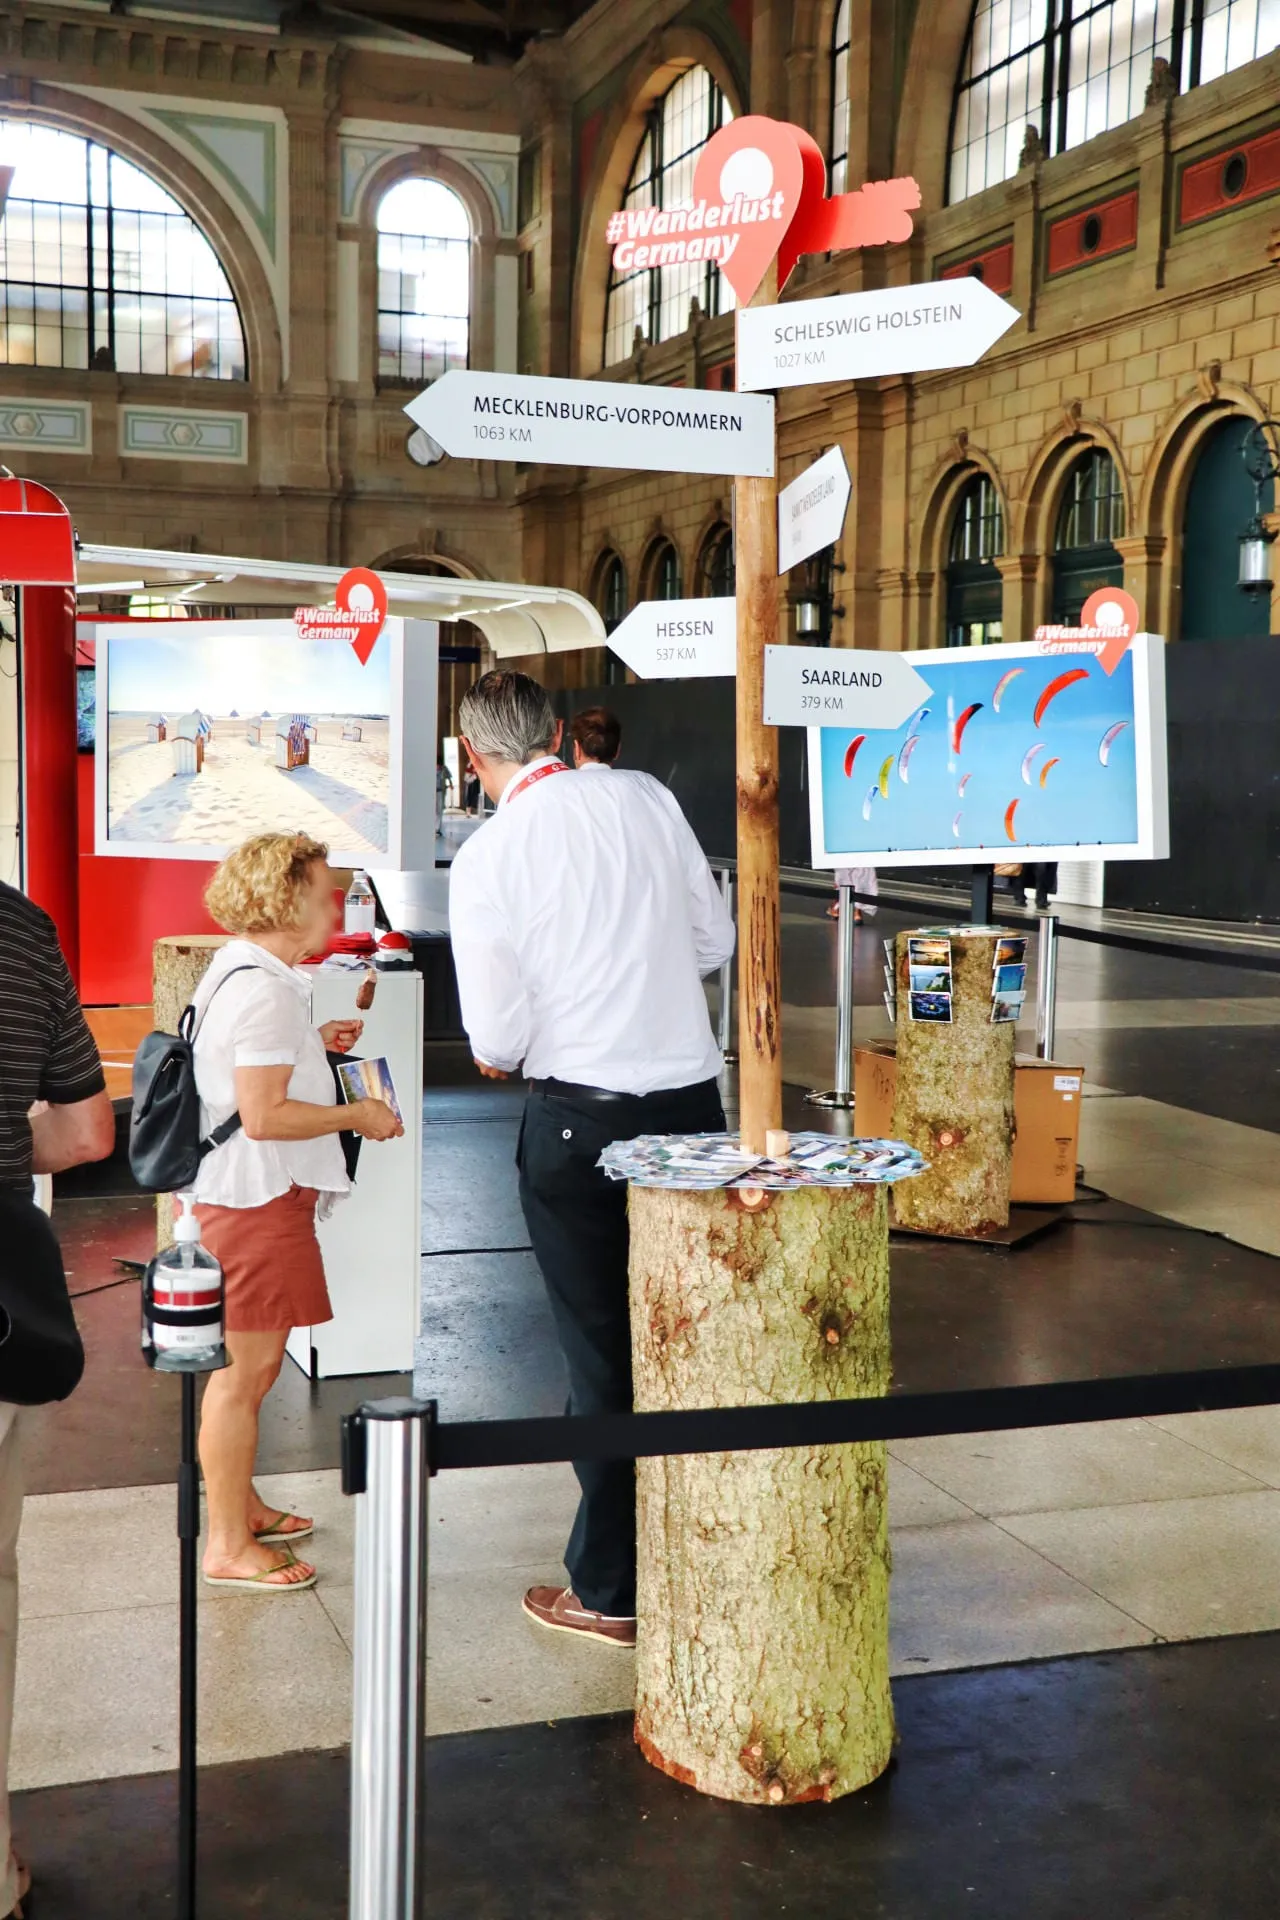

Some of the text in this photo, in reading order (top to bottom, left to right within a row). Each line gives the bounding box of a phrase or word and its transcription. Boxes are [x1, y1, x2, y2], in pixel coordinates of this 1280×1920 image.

[606, 191, 784, 243] #Wanderlust
[613, 233, 740, 270] Germany
[774, 304, 962, 344] SCHLESWIG HOLSTEIN
[774, 350, 826, 368] 1027 KM
[474, 396, 742, 431] MECKLENBURG-VORPOMMERN
[473, 425, 532, 442] 1063 KM
[294, 607, 380, 624] #Wanderlust
[298, 624, 360, 643] Germany
[656, 620, 714, 637] HESSEN
[1035, 623, 1129, 640] #Wanderlust
[656, 647, 697, 661] 537 KM
[1040, 640, 1107, 656] Germany
[801, 669, 882, 688] SAARLAND
[801, 696, 843, 710] 379 KM
